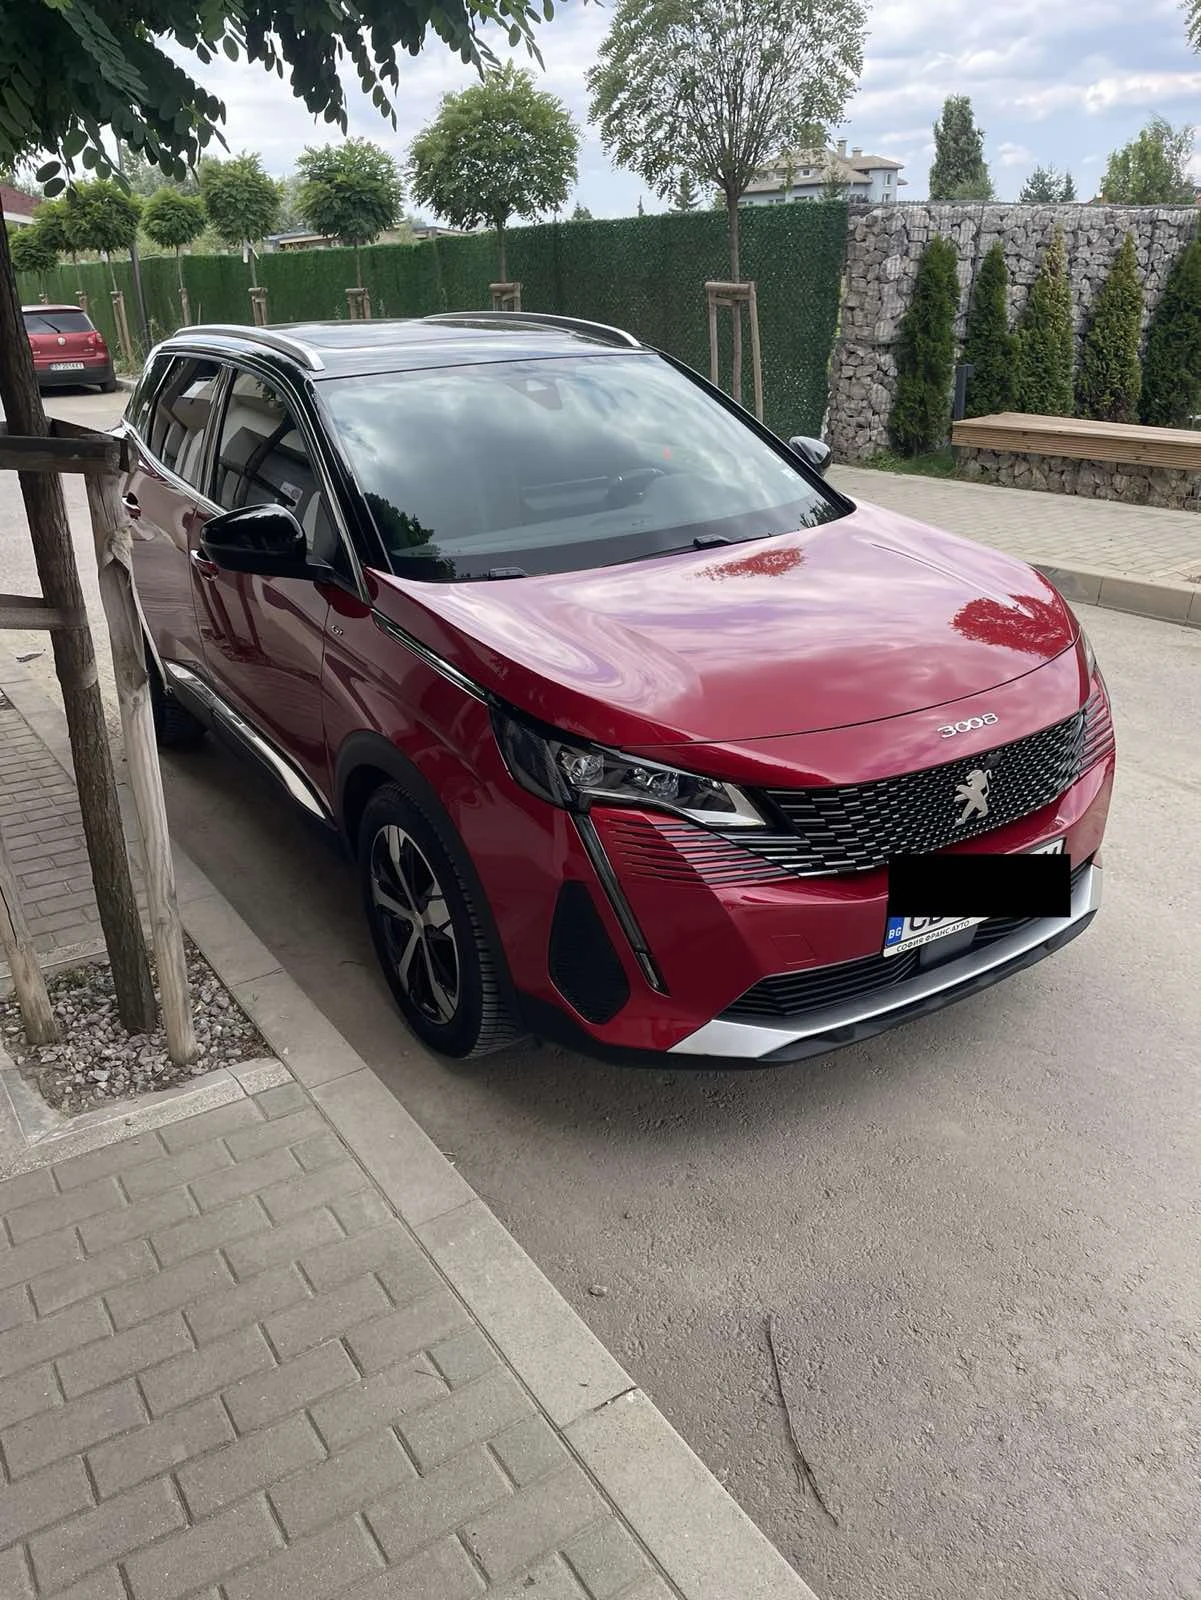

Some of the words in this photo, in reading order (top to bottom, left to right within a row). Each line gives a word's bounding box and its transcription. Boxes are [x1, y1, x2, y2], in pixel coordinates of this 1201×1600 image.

[937, 713, 998, 738] 3008
[888, 927, 902, 939] BG
[896, 938, 924, 952] СОФИЯ
[925, 928, 951, 941] ФРАНС
[951, 920, 970, 931] АУТО
